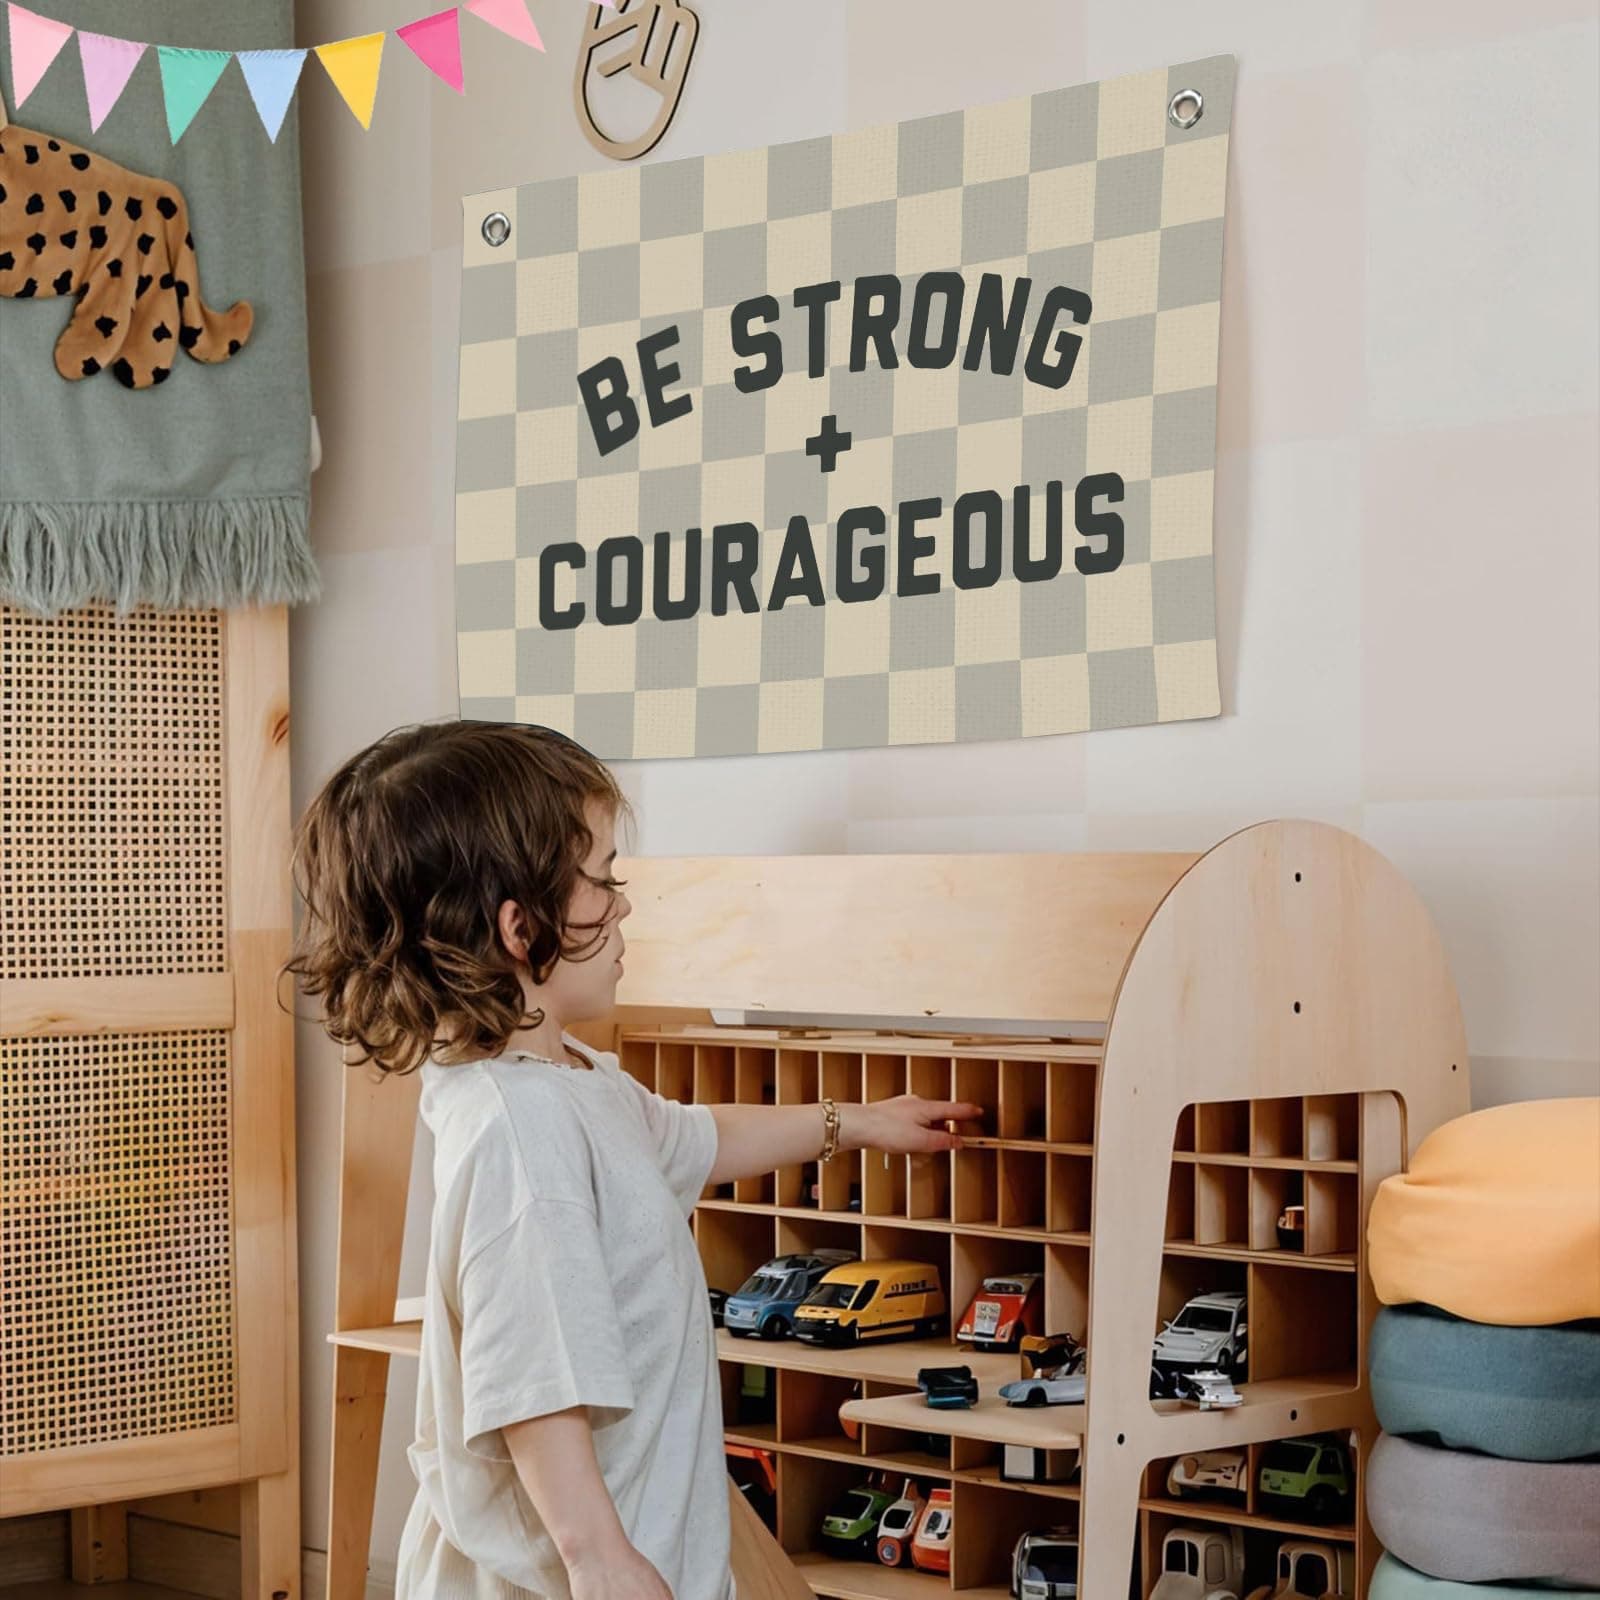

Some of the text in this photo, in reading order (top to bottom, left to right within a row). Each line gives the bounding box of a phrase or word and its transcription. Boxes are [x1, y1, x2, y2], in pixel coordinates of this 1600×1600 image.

[577, 271, 1093, 457] BE STRONG
[539, 472, 1125, 631] COURAGEOUS
